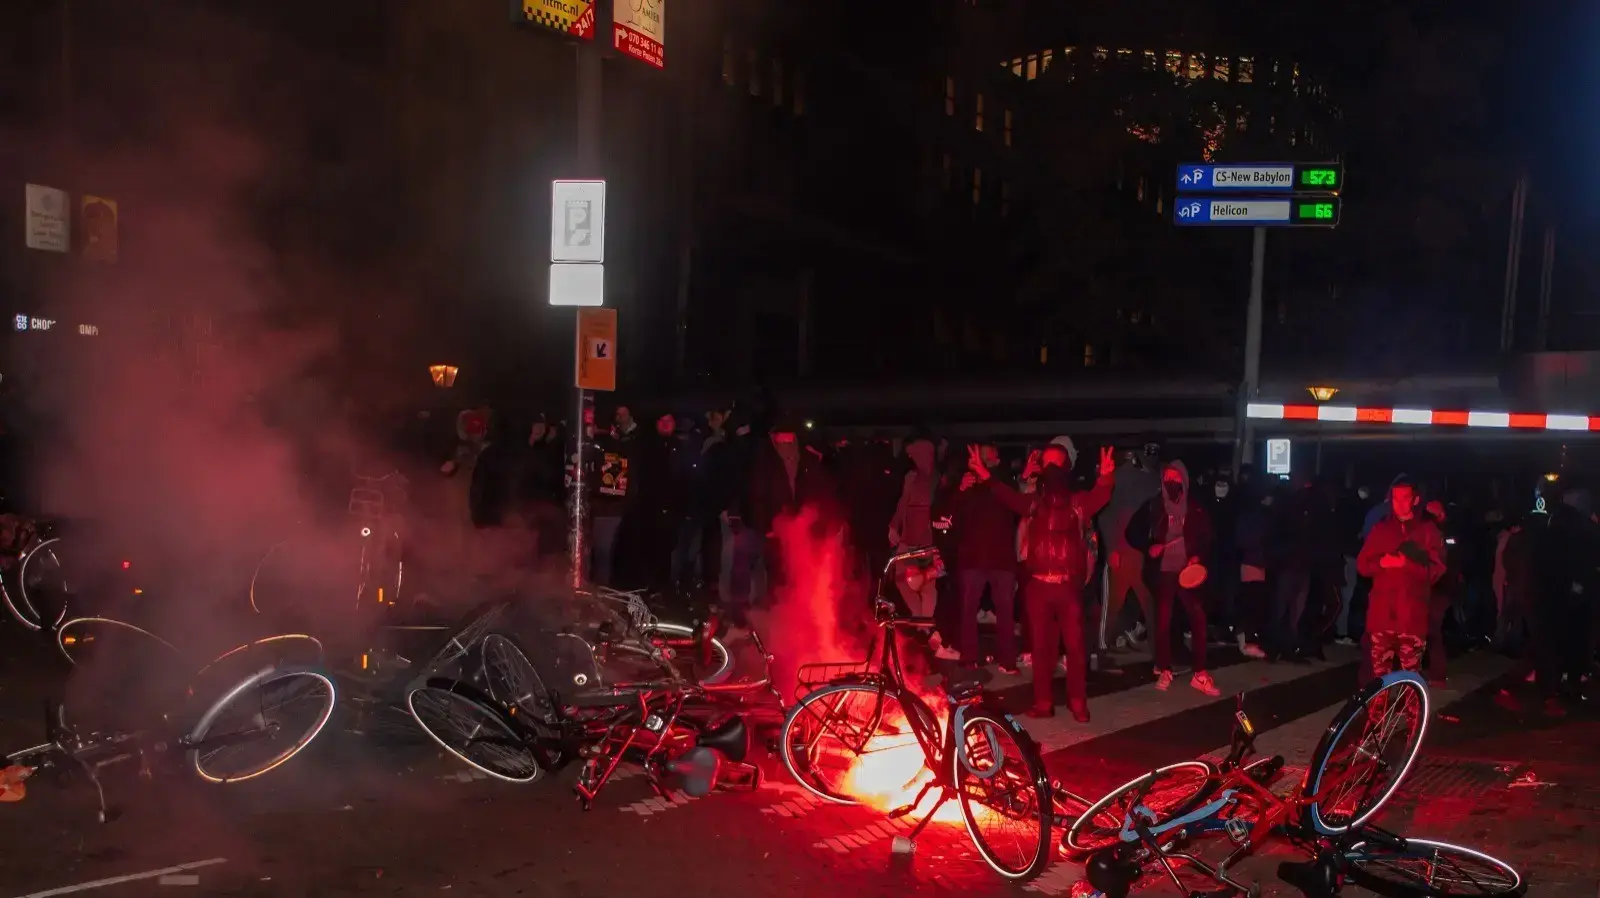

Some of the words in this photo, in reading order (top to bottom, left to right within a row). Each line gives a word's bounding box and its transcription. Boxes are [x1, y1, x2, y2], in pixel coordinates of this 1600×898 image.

[575, 8, 594, 37] 24/7
[628, 32, 640, 45] 070
[1215, 171, 1251, 182] CS-New
[1253, 171, 1291, 184] Babylon
[1310, 170, 1335, 184] 573
[1213, 204, 1248, 216] Helicon
[1315, 203, 1333, 218] 66
